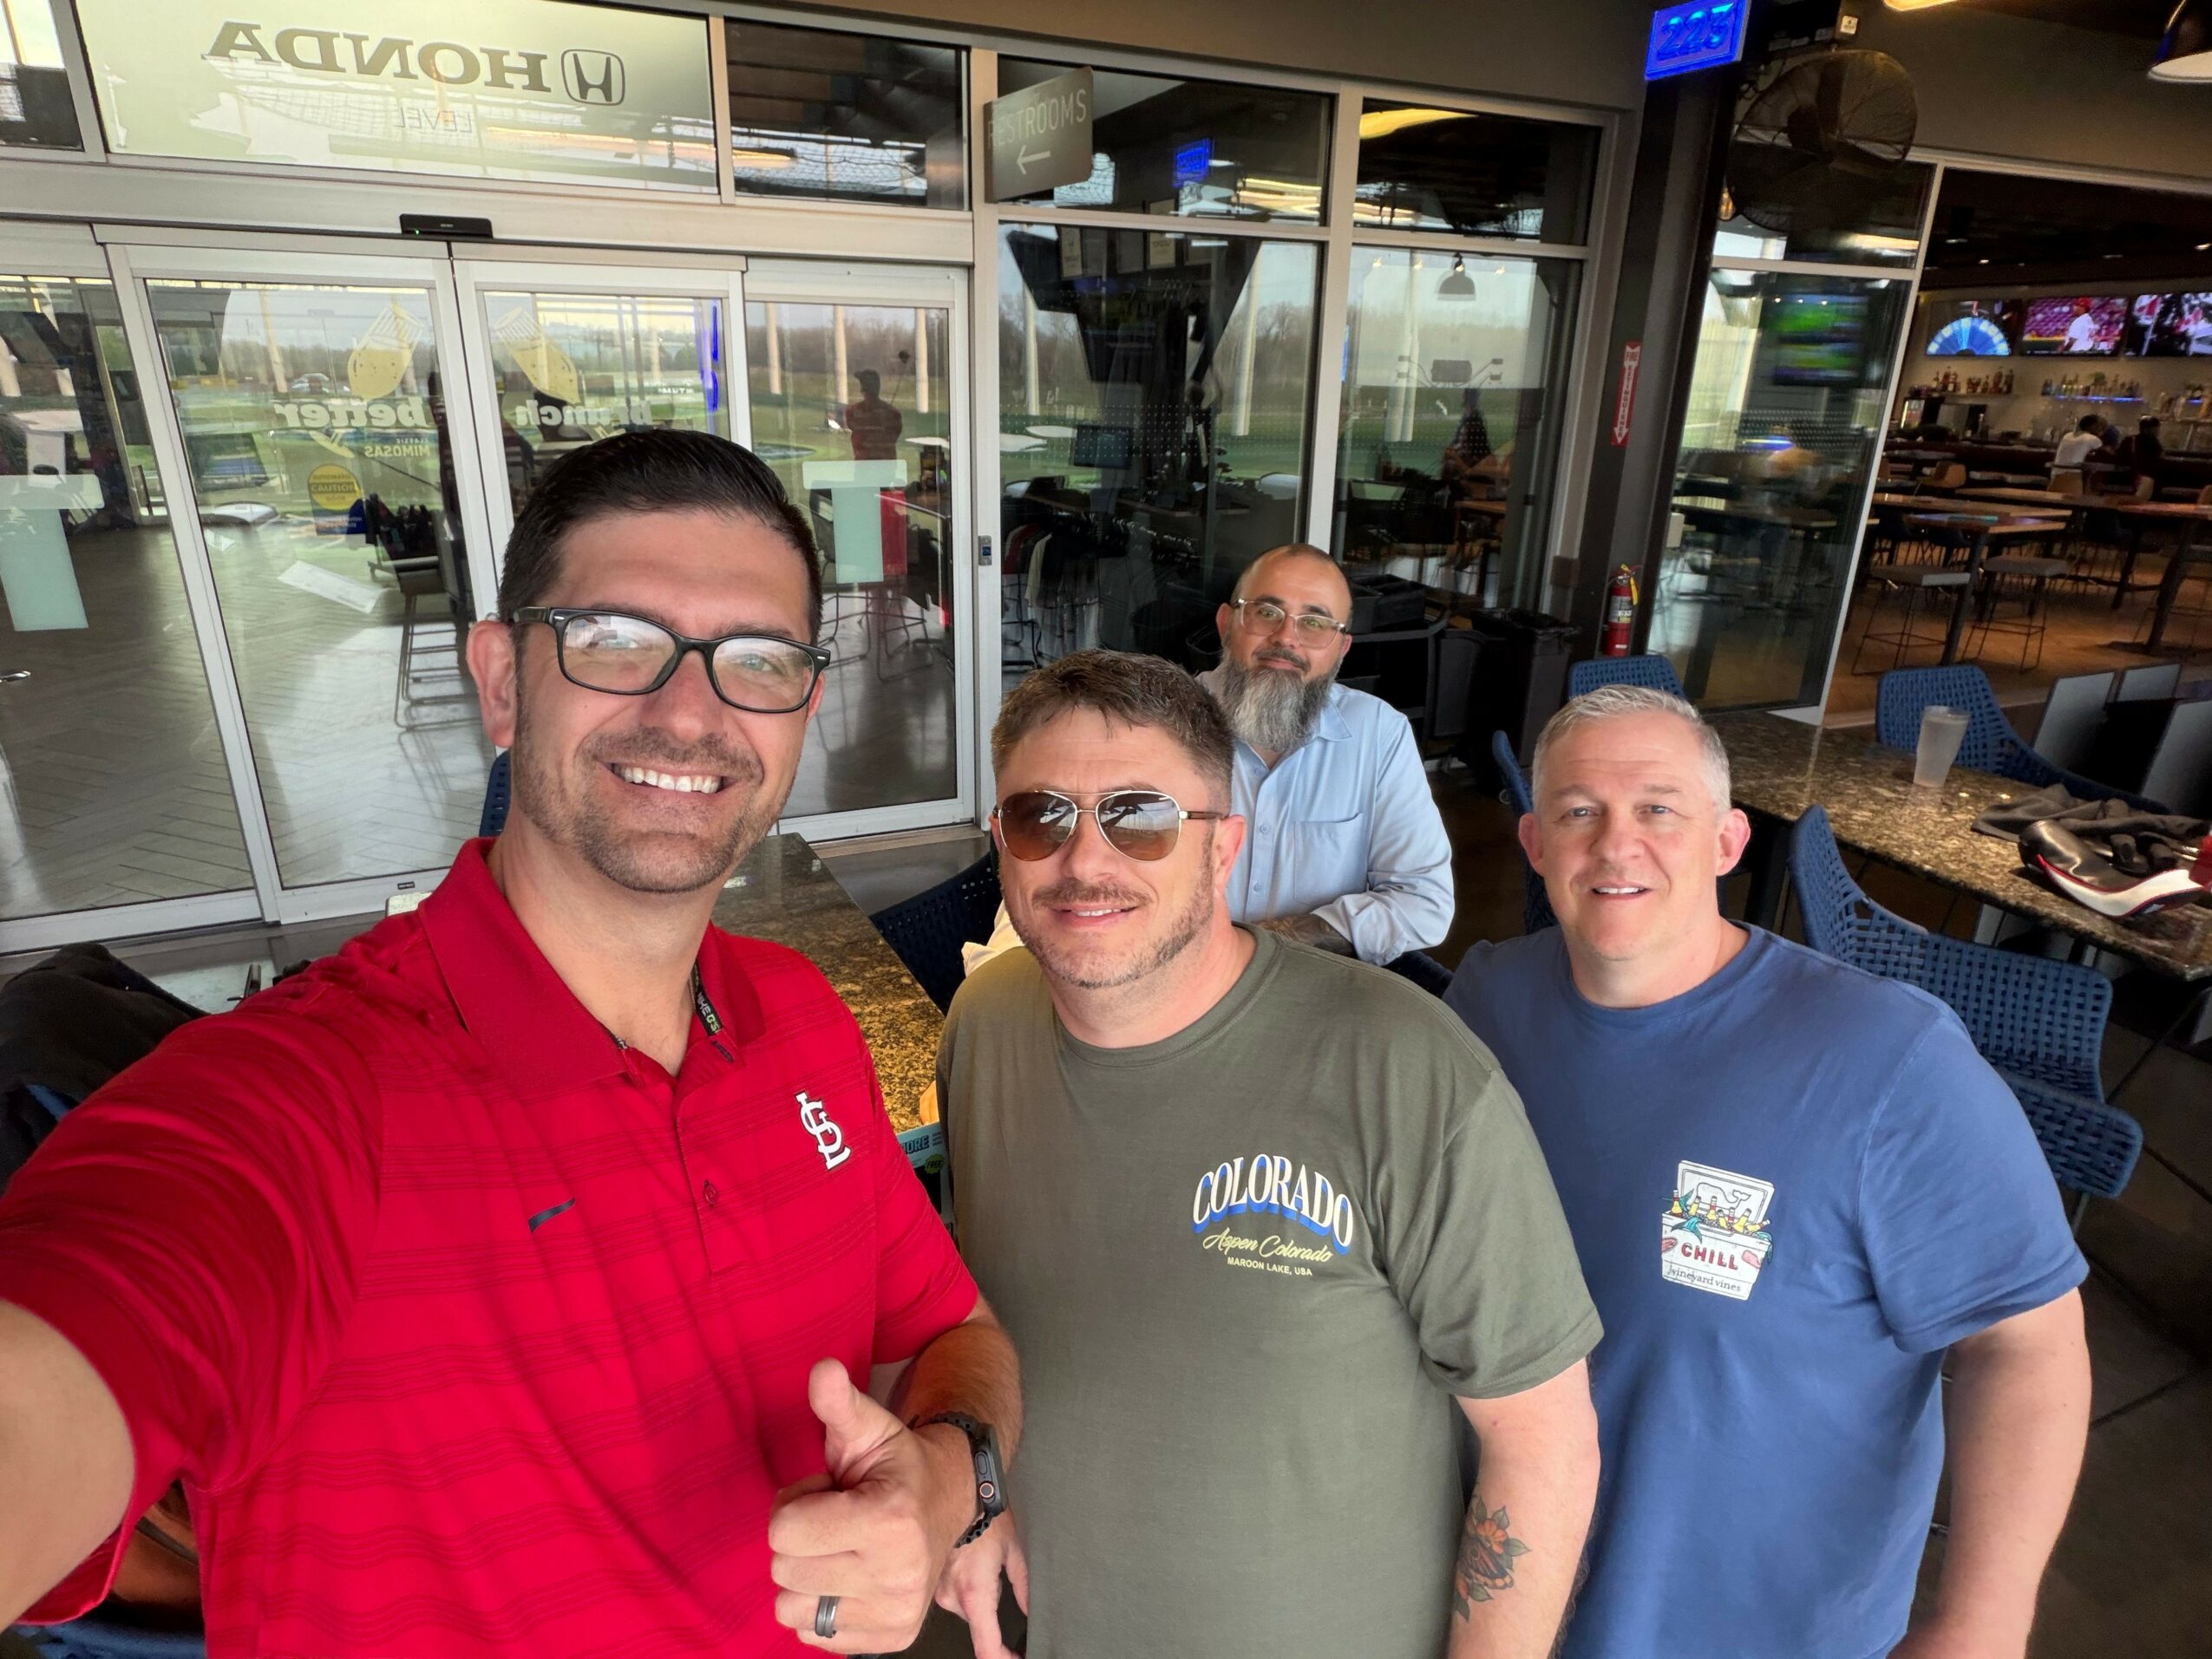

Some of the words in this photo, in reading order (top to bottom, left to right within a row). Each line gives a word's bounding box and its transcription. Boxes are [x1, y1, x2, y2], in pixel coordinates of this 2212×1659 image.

[987, 89, 1087, 147] RESTROOMS
[1618, 364, 1632, 438] EXTINGUISHER
[926, 1159, 943, 1169] FREE
[1192, 1153, 1354, 1255] COLORADO
[1202, 1227, 1259, 1256] Aspen
[1259, 1235, 1333, 1263] Colorado
[1681, 1242, 1738, 1270] CHILL
[1227, 1257, 1265, 1270] MAROON
[1266, 1264, 1293, 1276] LAKE,
[1294, 1267, 1313, 1277] USA
[1669, 1267, 1714, 1285] vineyard
[1715, 1279, 1742, 1292] vines
